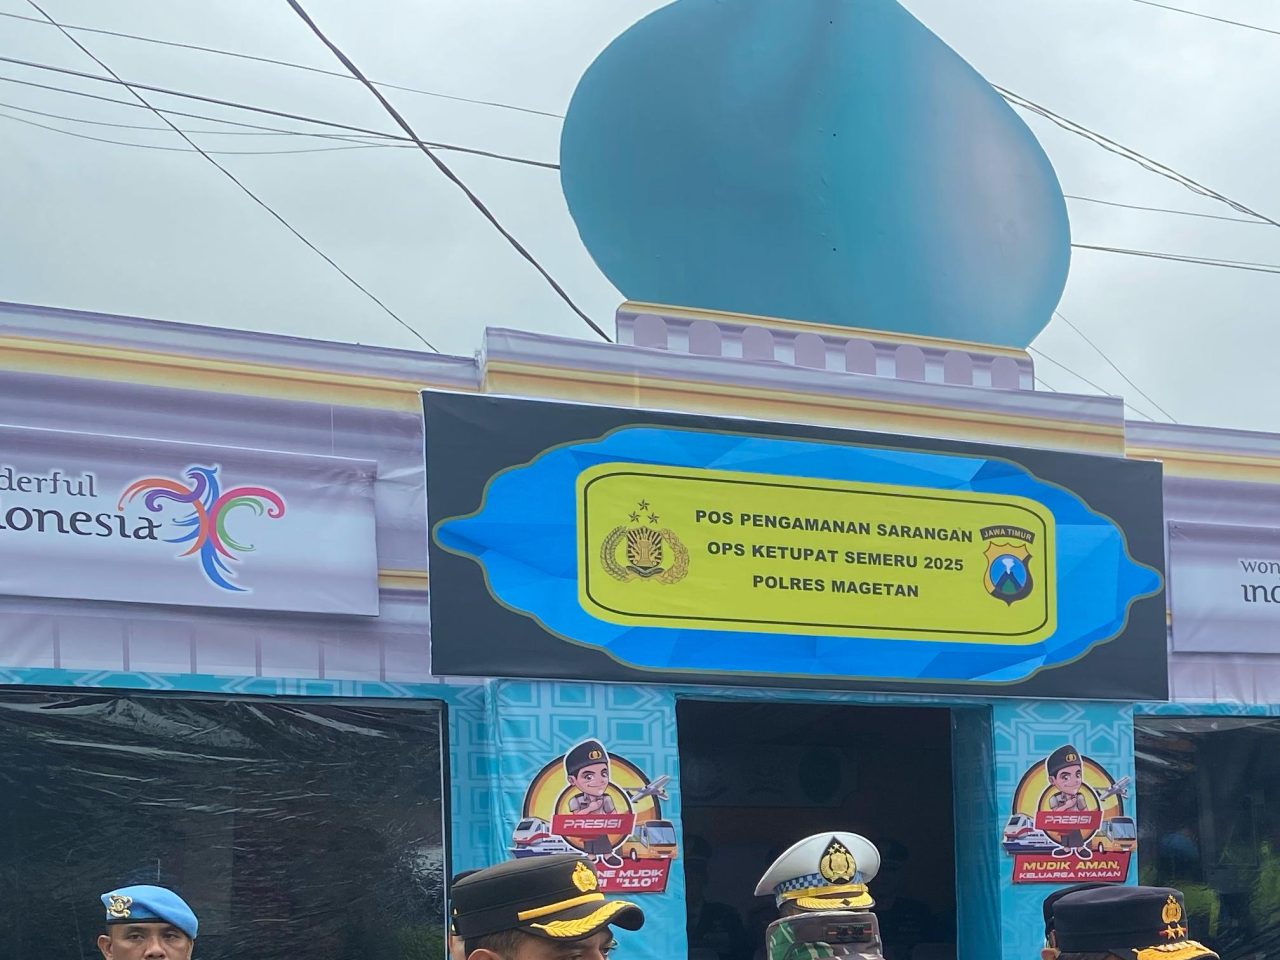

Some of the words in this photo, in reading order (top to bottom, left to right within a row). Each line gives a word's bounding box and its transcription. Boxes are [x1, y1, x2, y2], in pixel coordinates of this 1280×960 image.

[0, 467, 97, 497] derful
[0, 506, 162, 540] onesia
[695, 509, 734, 525] POS
[740, 513, 871, 537] PENGAMANAN
[877, 523, 973, 543] SARANGAN
[984, 528, 1006, 538] JAWA
[1008, 528, 1032, 541] TIMUR
[707, 541, 745, 557] OPS
[752, 545, 840, 563] KETUPAT
[844, 550, 919, 569] SEMERU
[923, 556, 964, 571] 2025
[752, 574, 825, 592] POLRES
[831, 579, 919, 598] MAGETAN
[563, 819, 622, 829] PRESISI
[1045, 815, 1092, 825] PRESISI
[1023, 861, 1070, 870] MUDIK
[1075, 860, 1120, 870] AMAN,
[619, 869, 664, 877] MUDIK
[1077, 870, 1121, 878] NYAMAN
